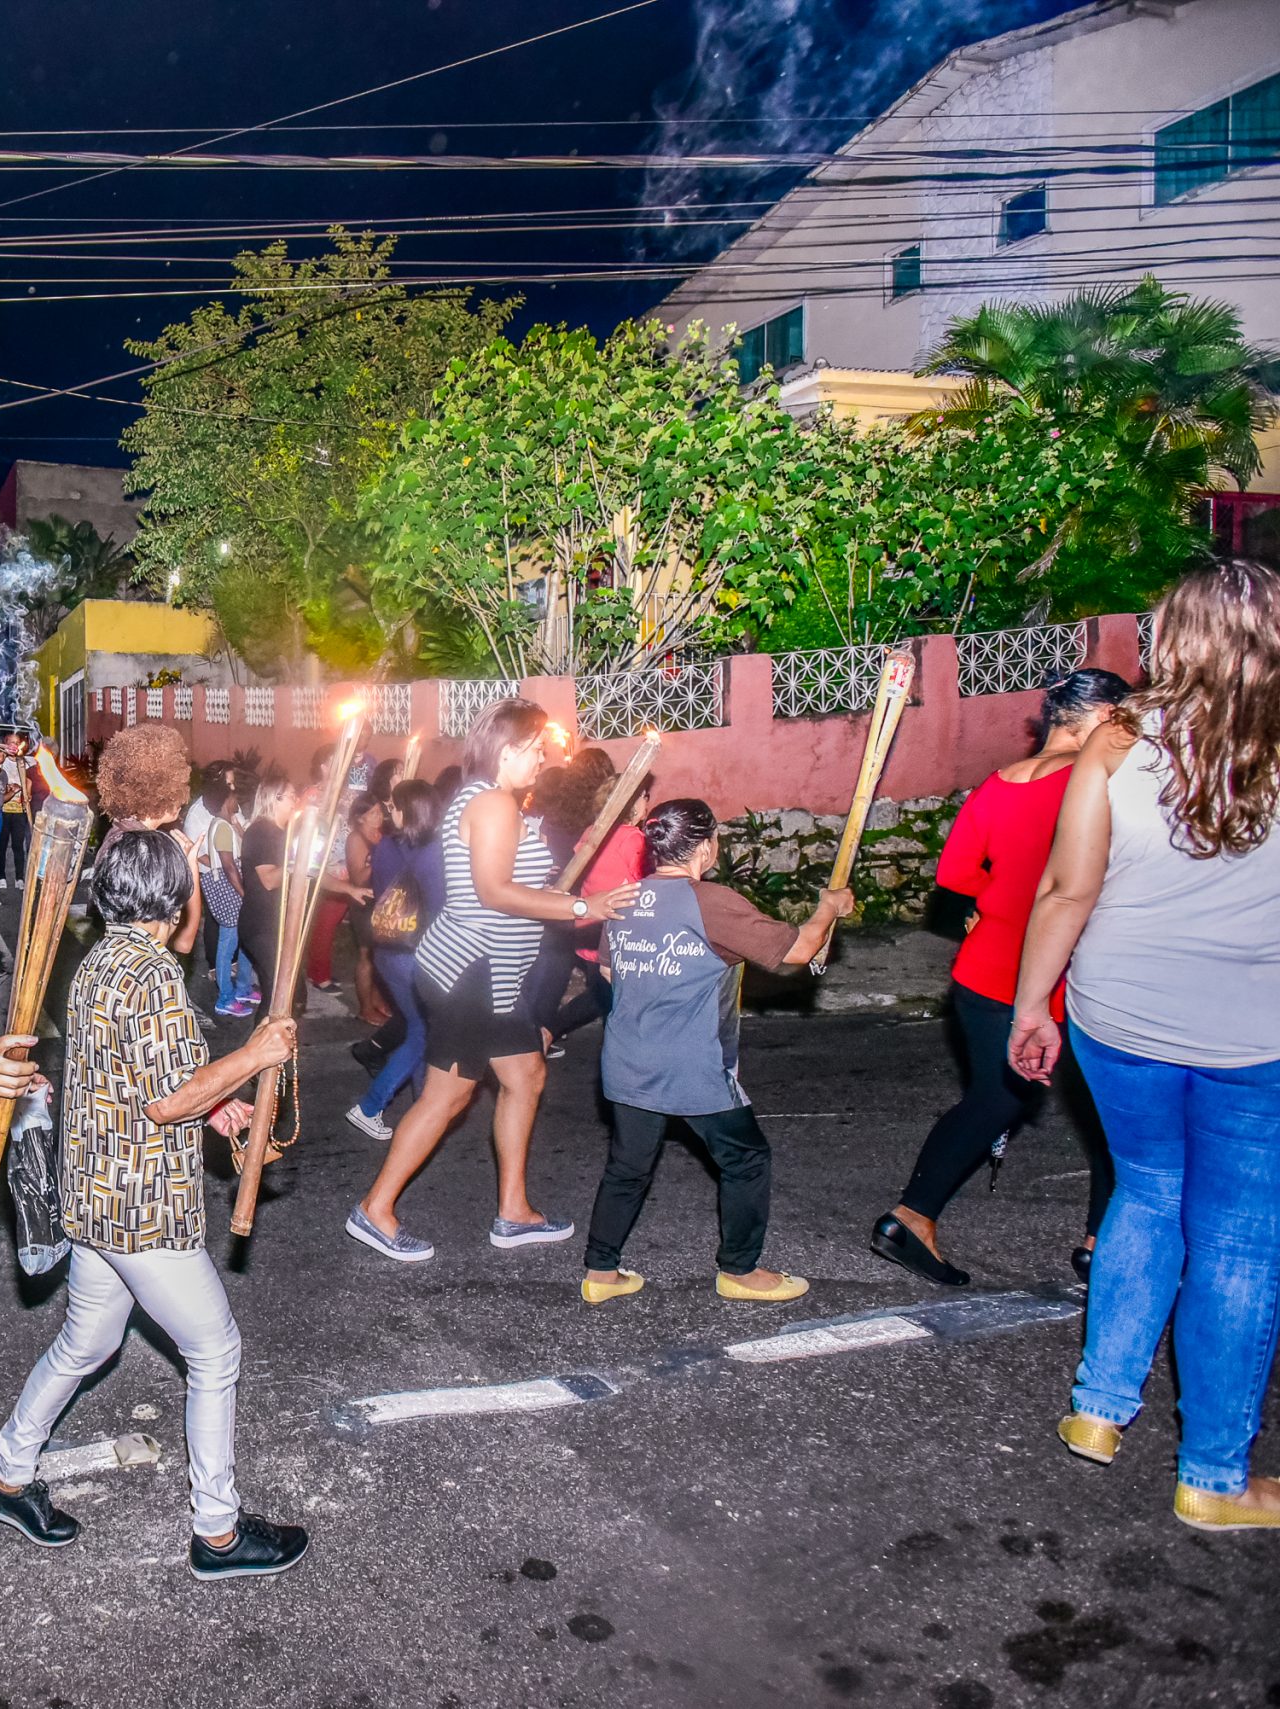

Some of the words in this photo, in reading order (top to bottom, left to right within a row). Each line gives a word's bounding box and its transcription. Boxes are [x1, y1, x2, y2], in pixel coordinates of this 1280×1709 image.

[617, 929, 658, 953] Francisco
[662, 931, 706, 957] Xavier
[614, 951, 637, 980] Rogai
[638, 960, 655, 978] por
[656, 953, 682, 977] Nós
